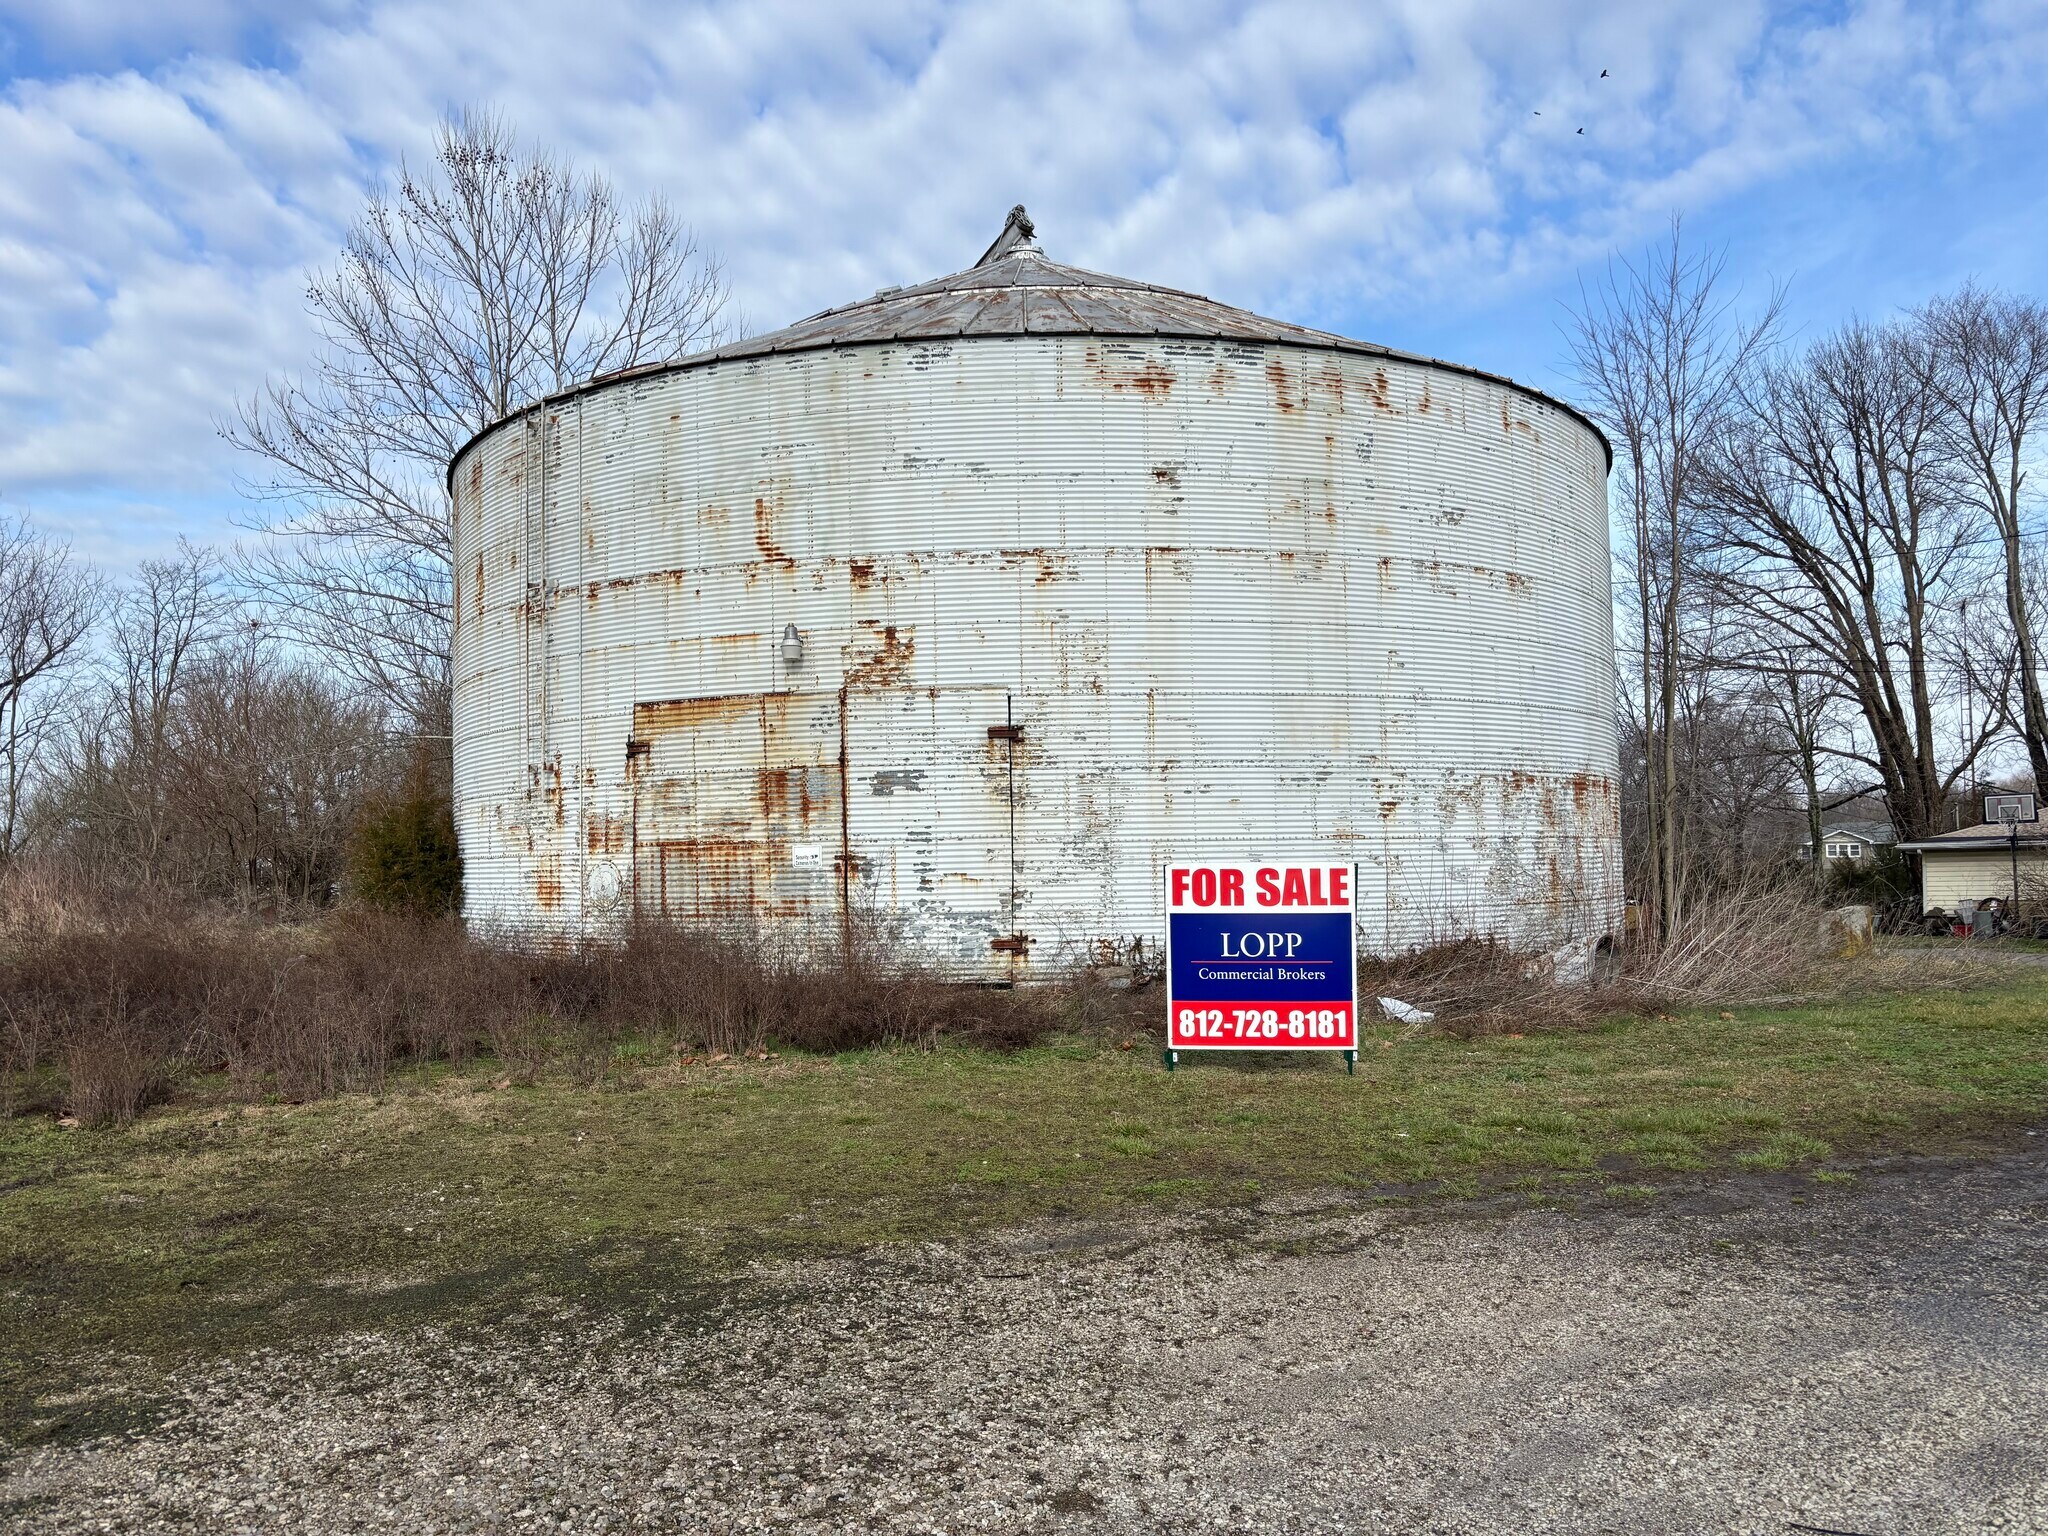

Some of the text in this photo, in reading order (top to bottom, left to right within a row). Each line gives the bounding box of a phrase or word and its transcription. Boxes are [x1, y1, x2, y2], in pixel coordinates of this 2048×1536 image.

[1171, 867, 1350, 907] FOR SALE
[1220, 932, 1303, 958] LOPP
[1198, 967, 1326, 981] Commercial Brokers
[1179, 1009, 1347, 1039] 812-728-8181
